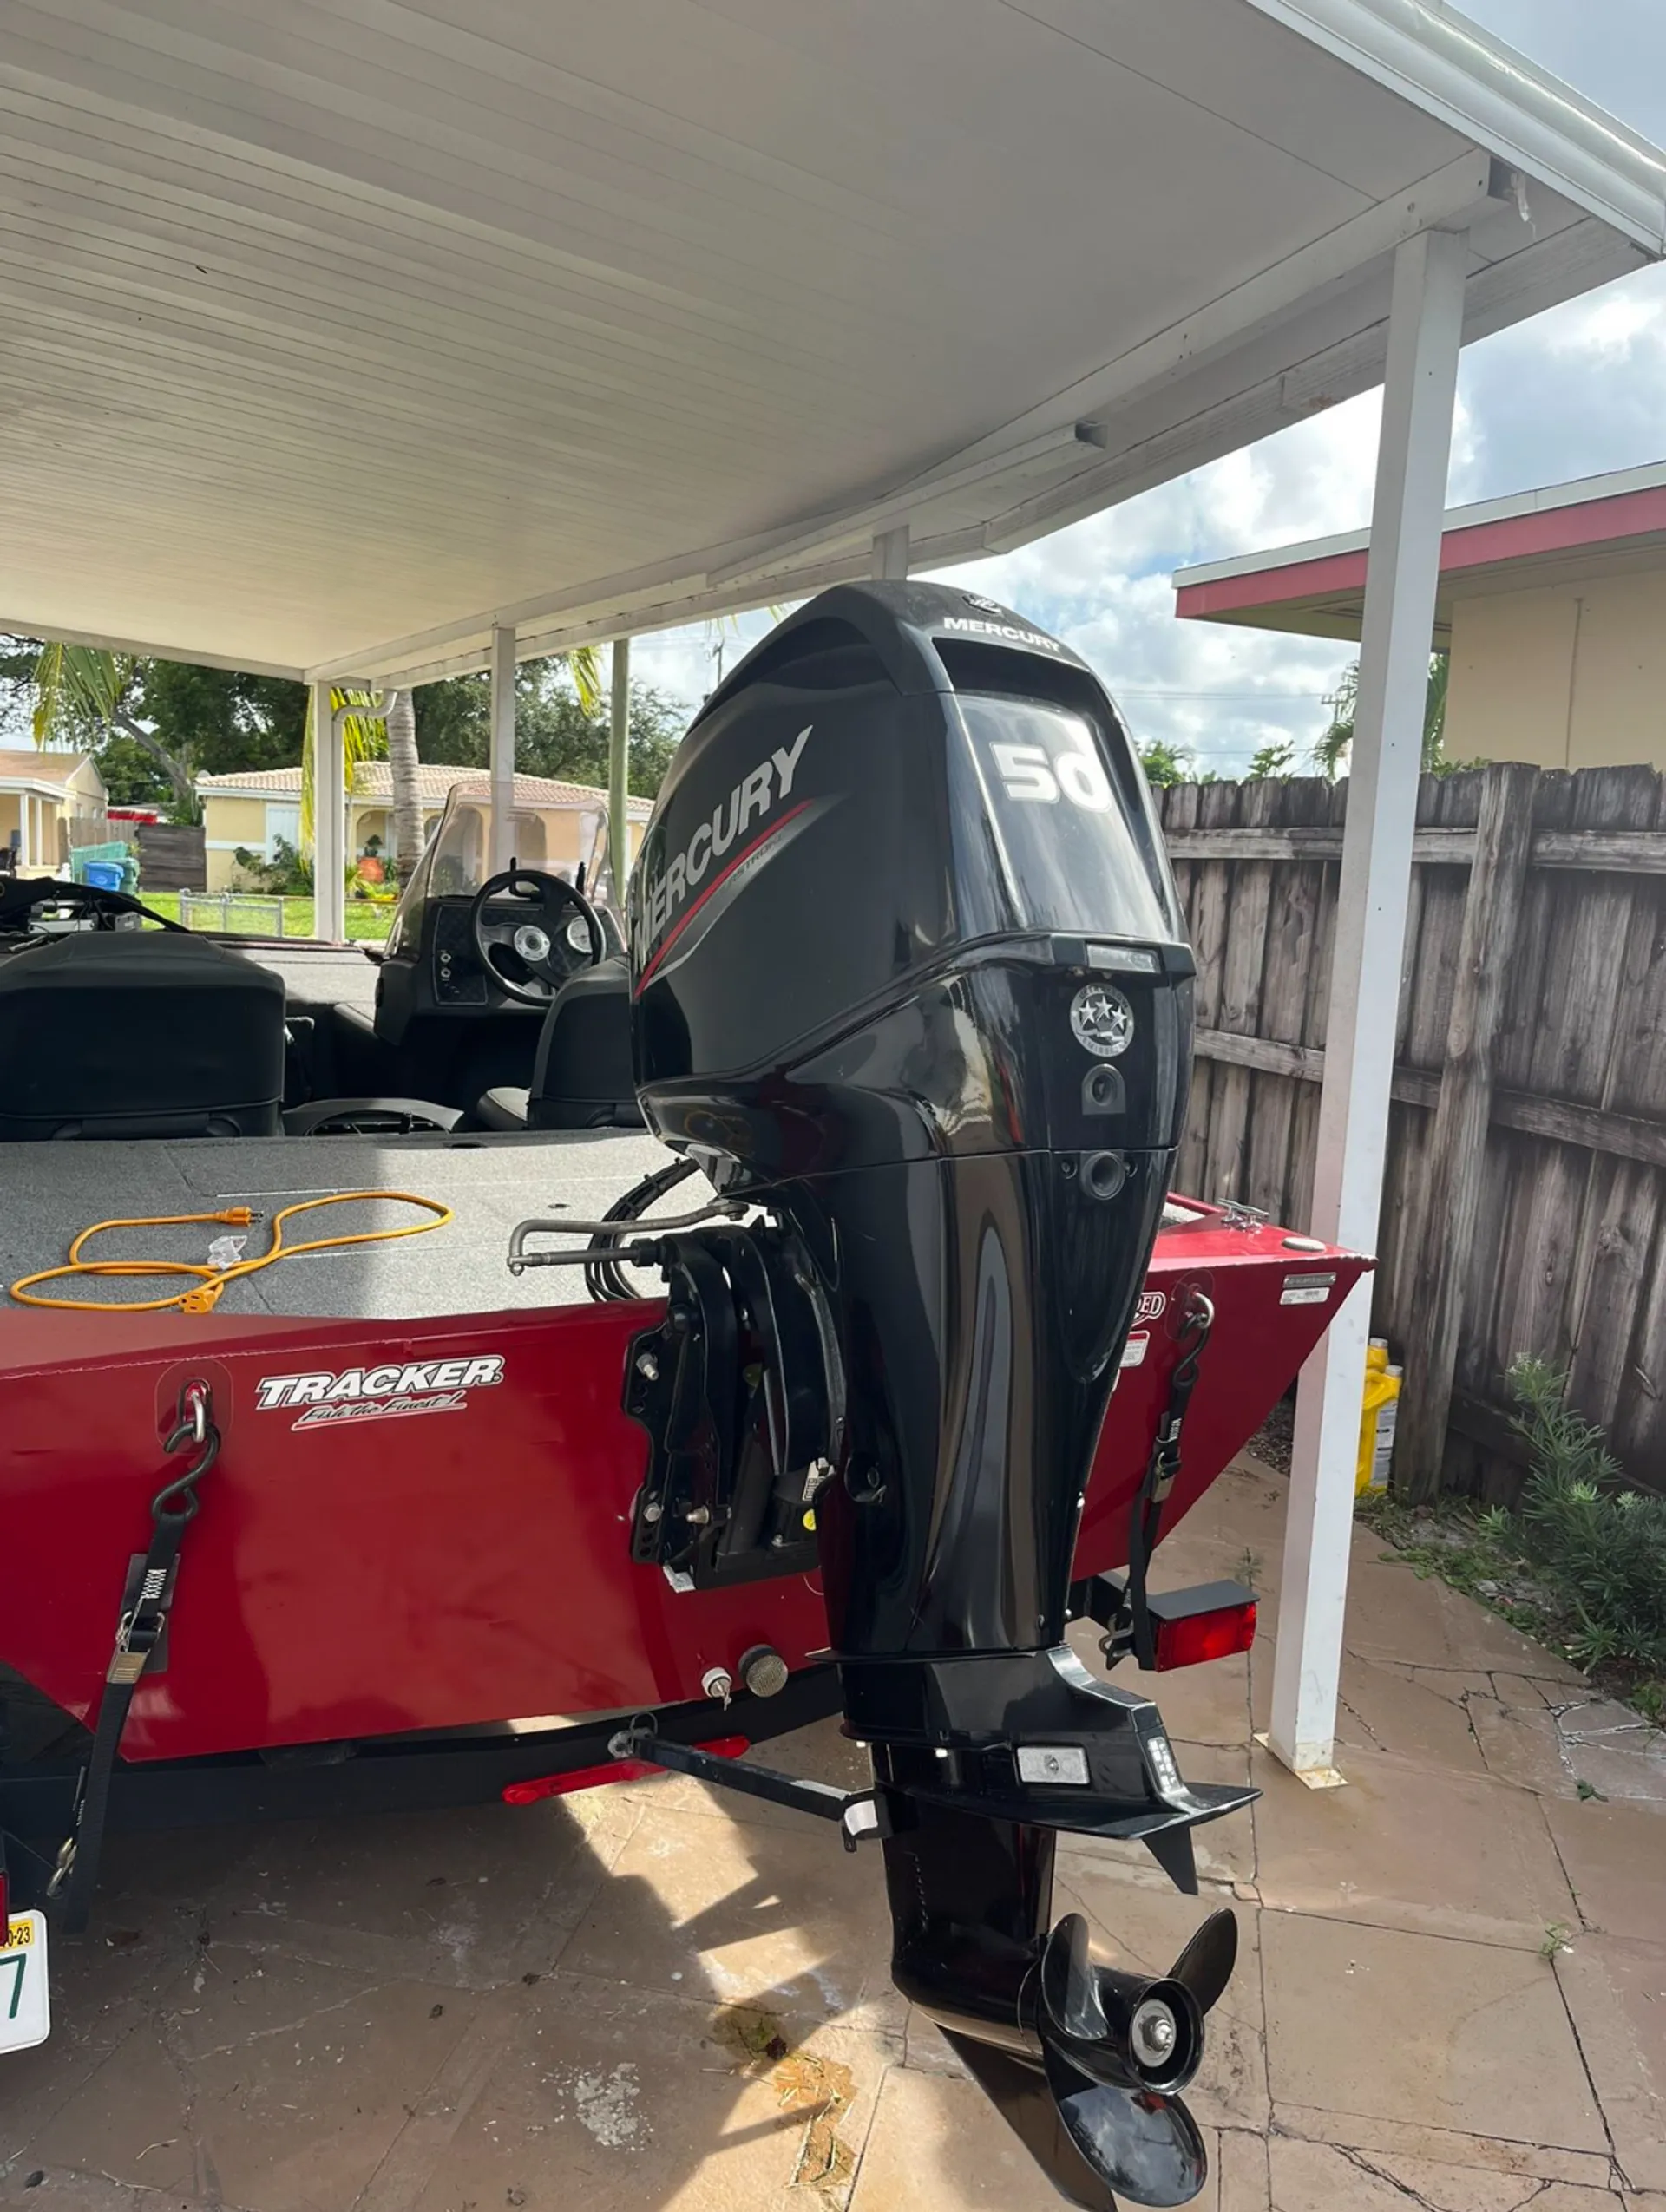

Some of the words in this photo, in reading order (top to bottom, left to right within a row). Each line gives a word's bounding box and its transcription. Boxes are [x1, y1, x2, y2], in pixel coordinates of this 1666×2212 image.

[943, 617, 1060, 652] MERCURY
[990, 743, 1112, 813] 50
[633, 724, 814, 974] MERCURY
[259, 1357, 501, 1409] TRACKER
[303, 1407, 346, 1422] Fish
[350, 1402, 378, 1417] the
[0, 1953, 27, 2019] 7
